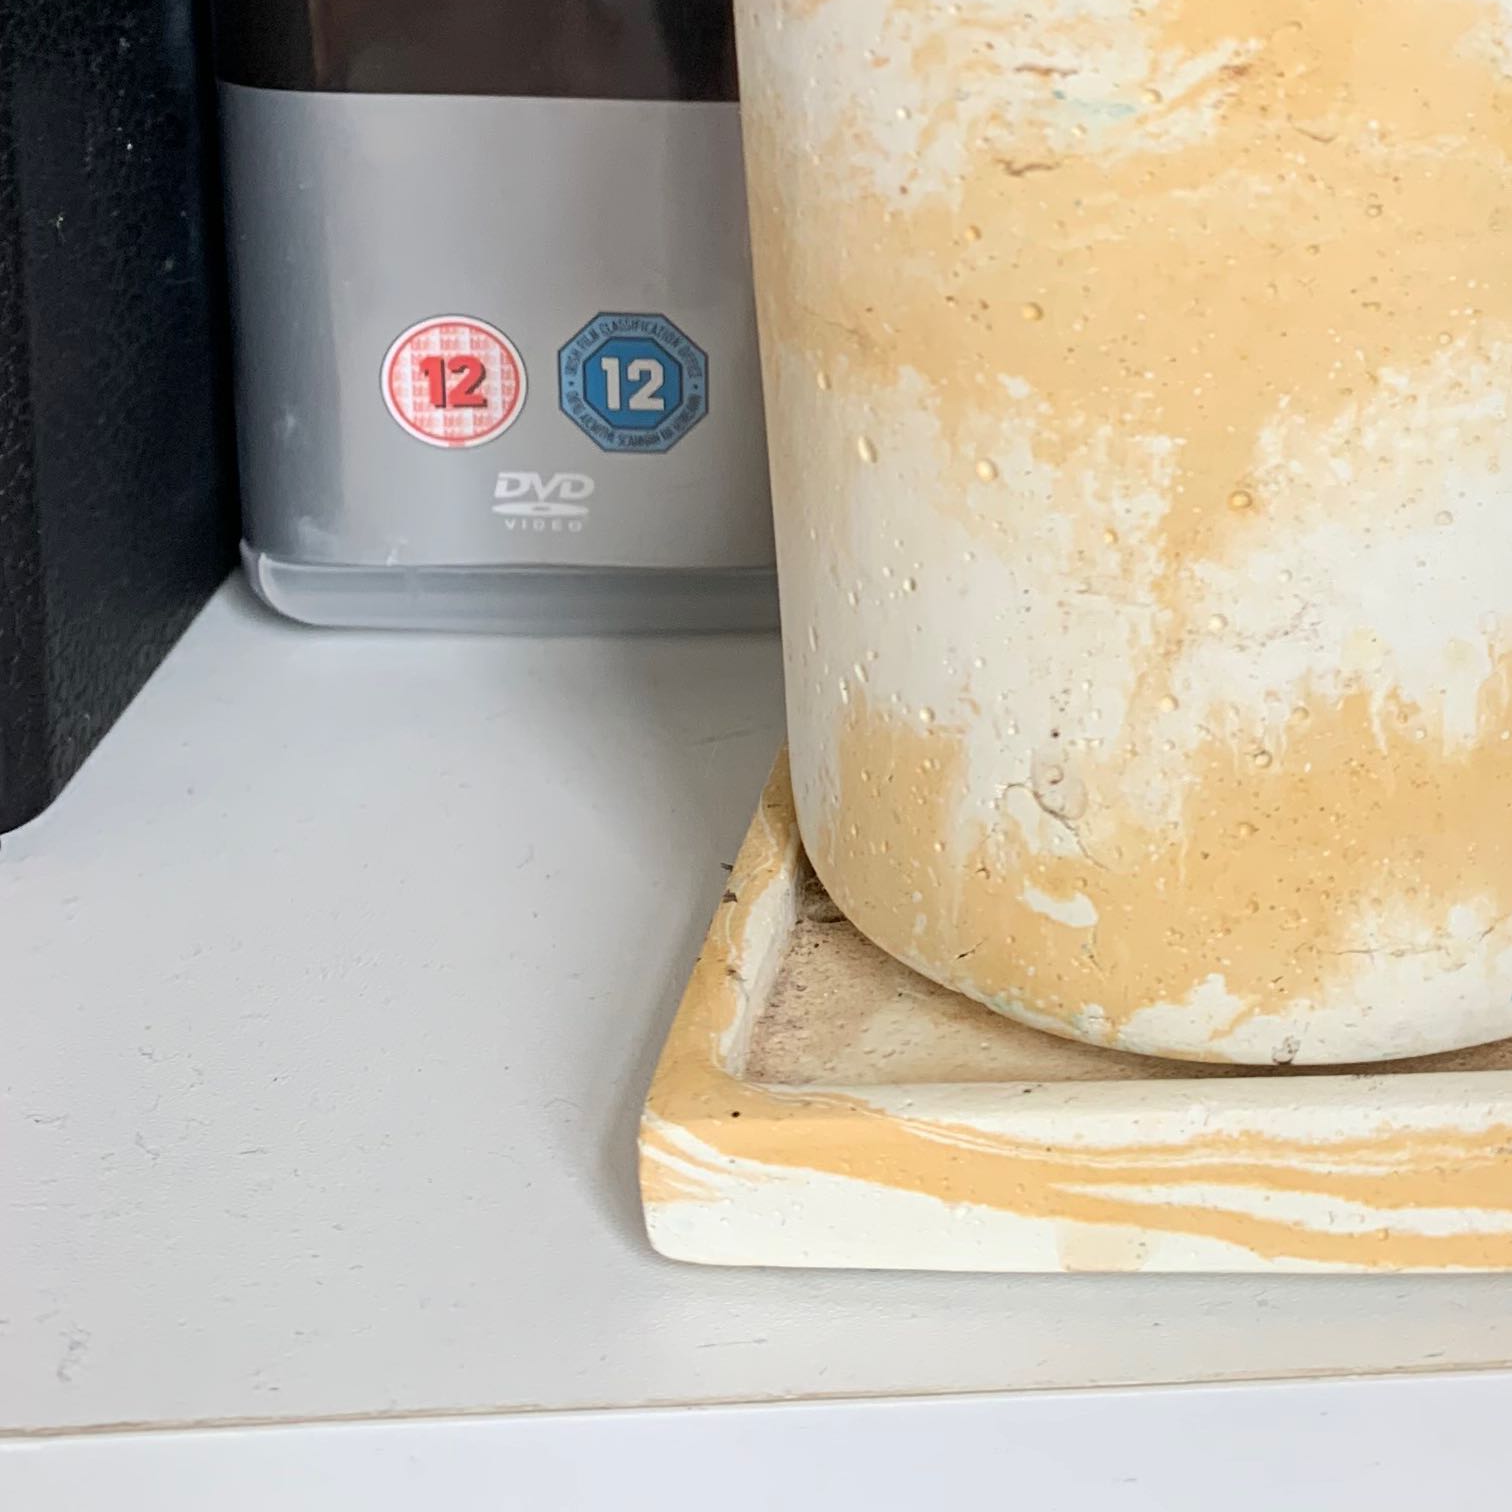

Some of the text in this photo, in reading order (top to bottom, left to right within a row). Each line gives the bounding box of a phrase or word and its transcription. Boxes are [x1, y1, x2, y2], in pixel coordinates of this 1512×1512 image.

[419, 355, 488, 409] 12
[601, 356, 665, 412] 12
[494, 471, 595, 504] DVD
[503, 518, 583, 533] VIDEO
